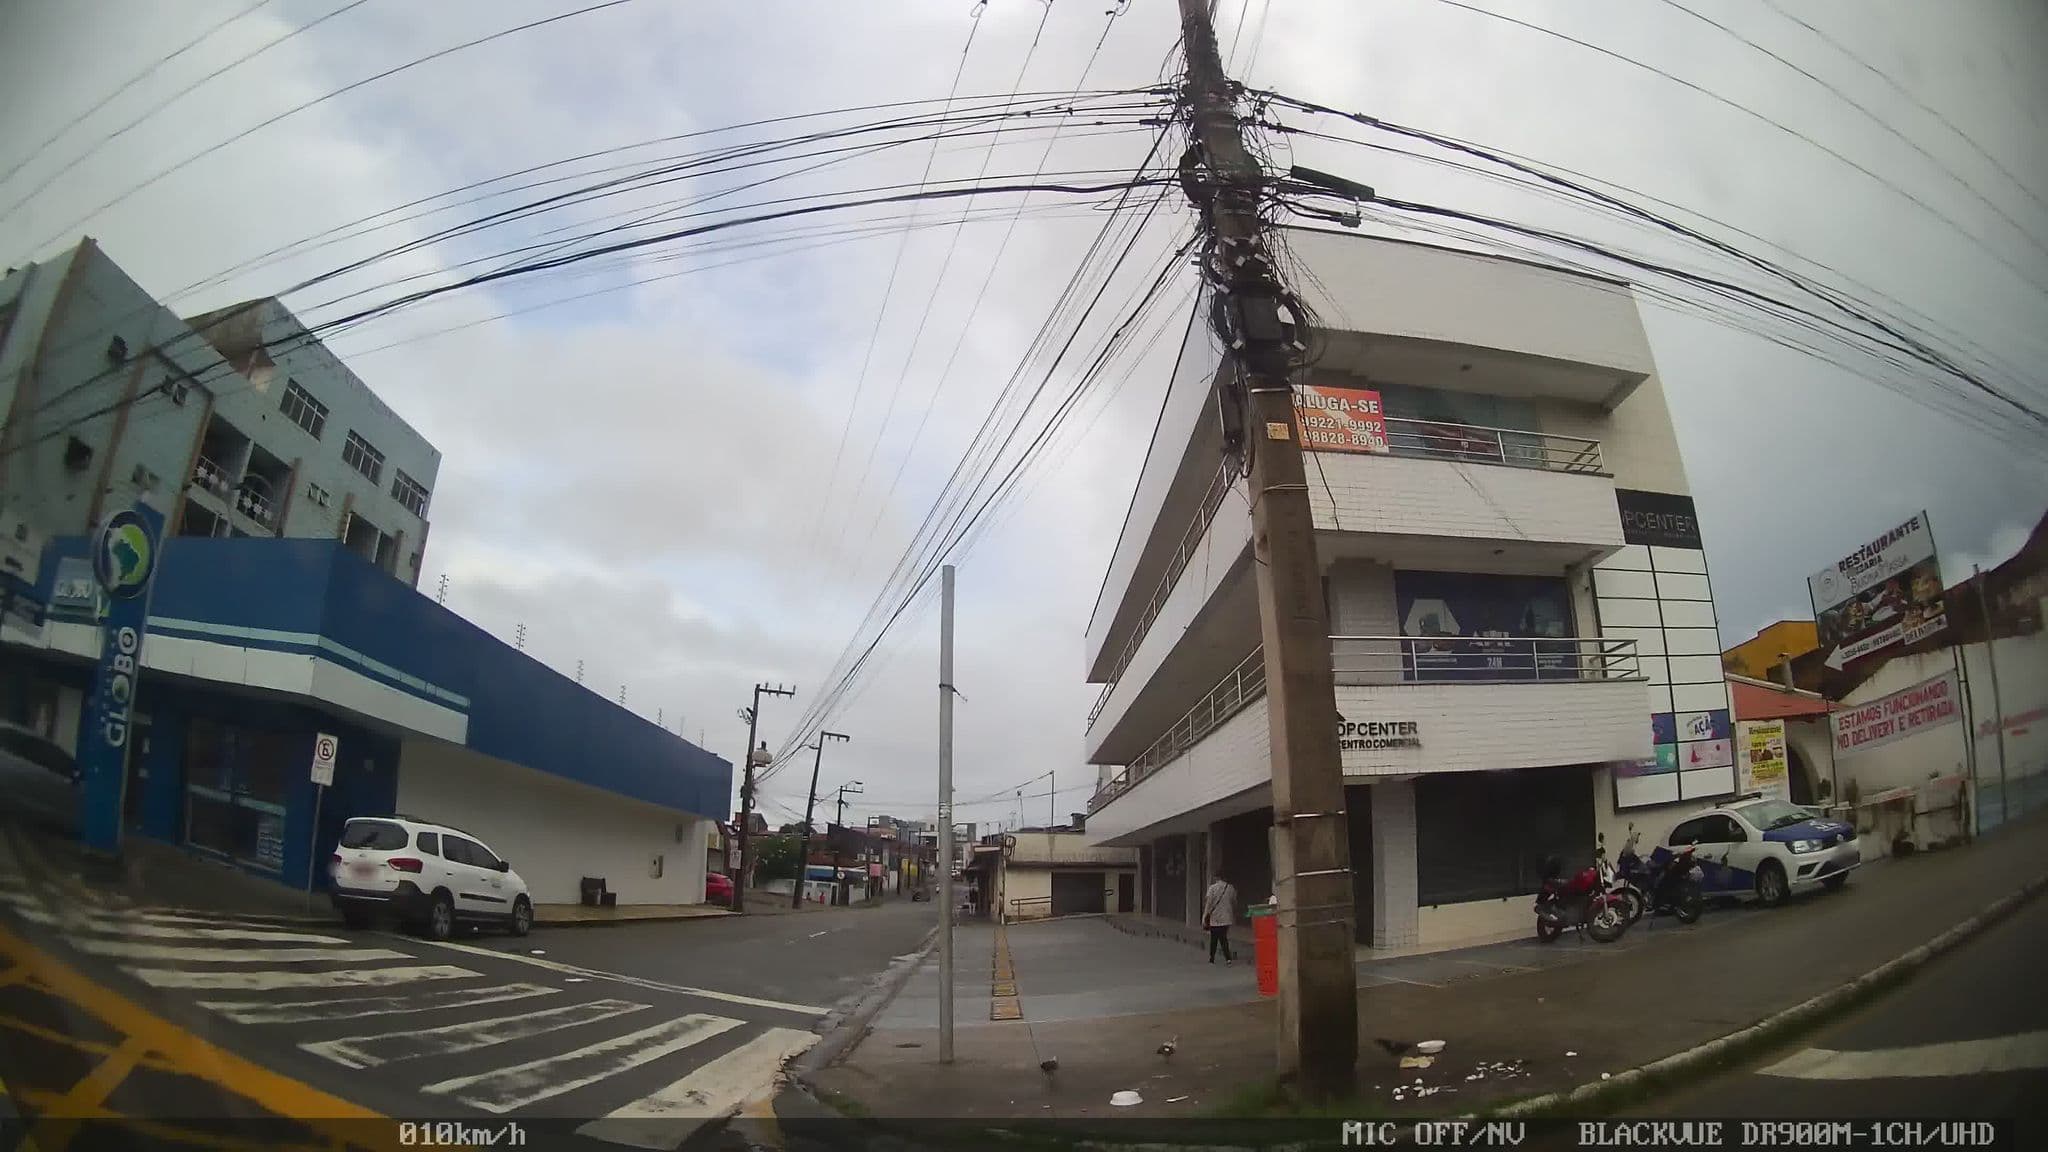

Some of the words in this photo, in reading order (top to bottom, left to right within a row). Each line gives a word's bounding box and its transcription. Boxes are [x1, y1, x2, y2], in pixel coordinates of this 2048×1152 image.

[1294, 394, 1380, 414] ALUGA-SE
[1301, 417, 1382, 433] 99221-9992
[1838, 516, 1920, 573] RESTAURANTE
[105, 626, 138, 747] GLOBO
[1838, 706, 1882, 731] ESTAMOS
[1851, 720, 1895, 746] DELIVERY
[1898, 716, 1906, 731] E
[1338, 739, 1372, 749] ENTRO
